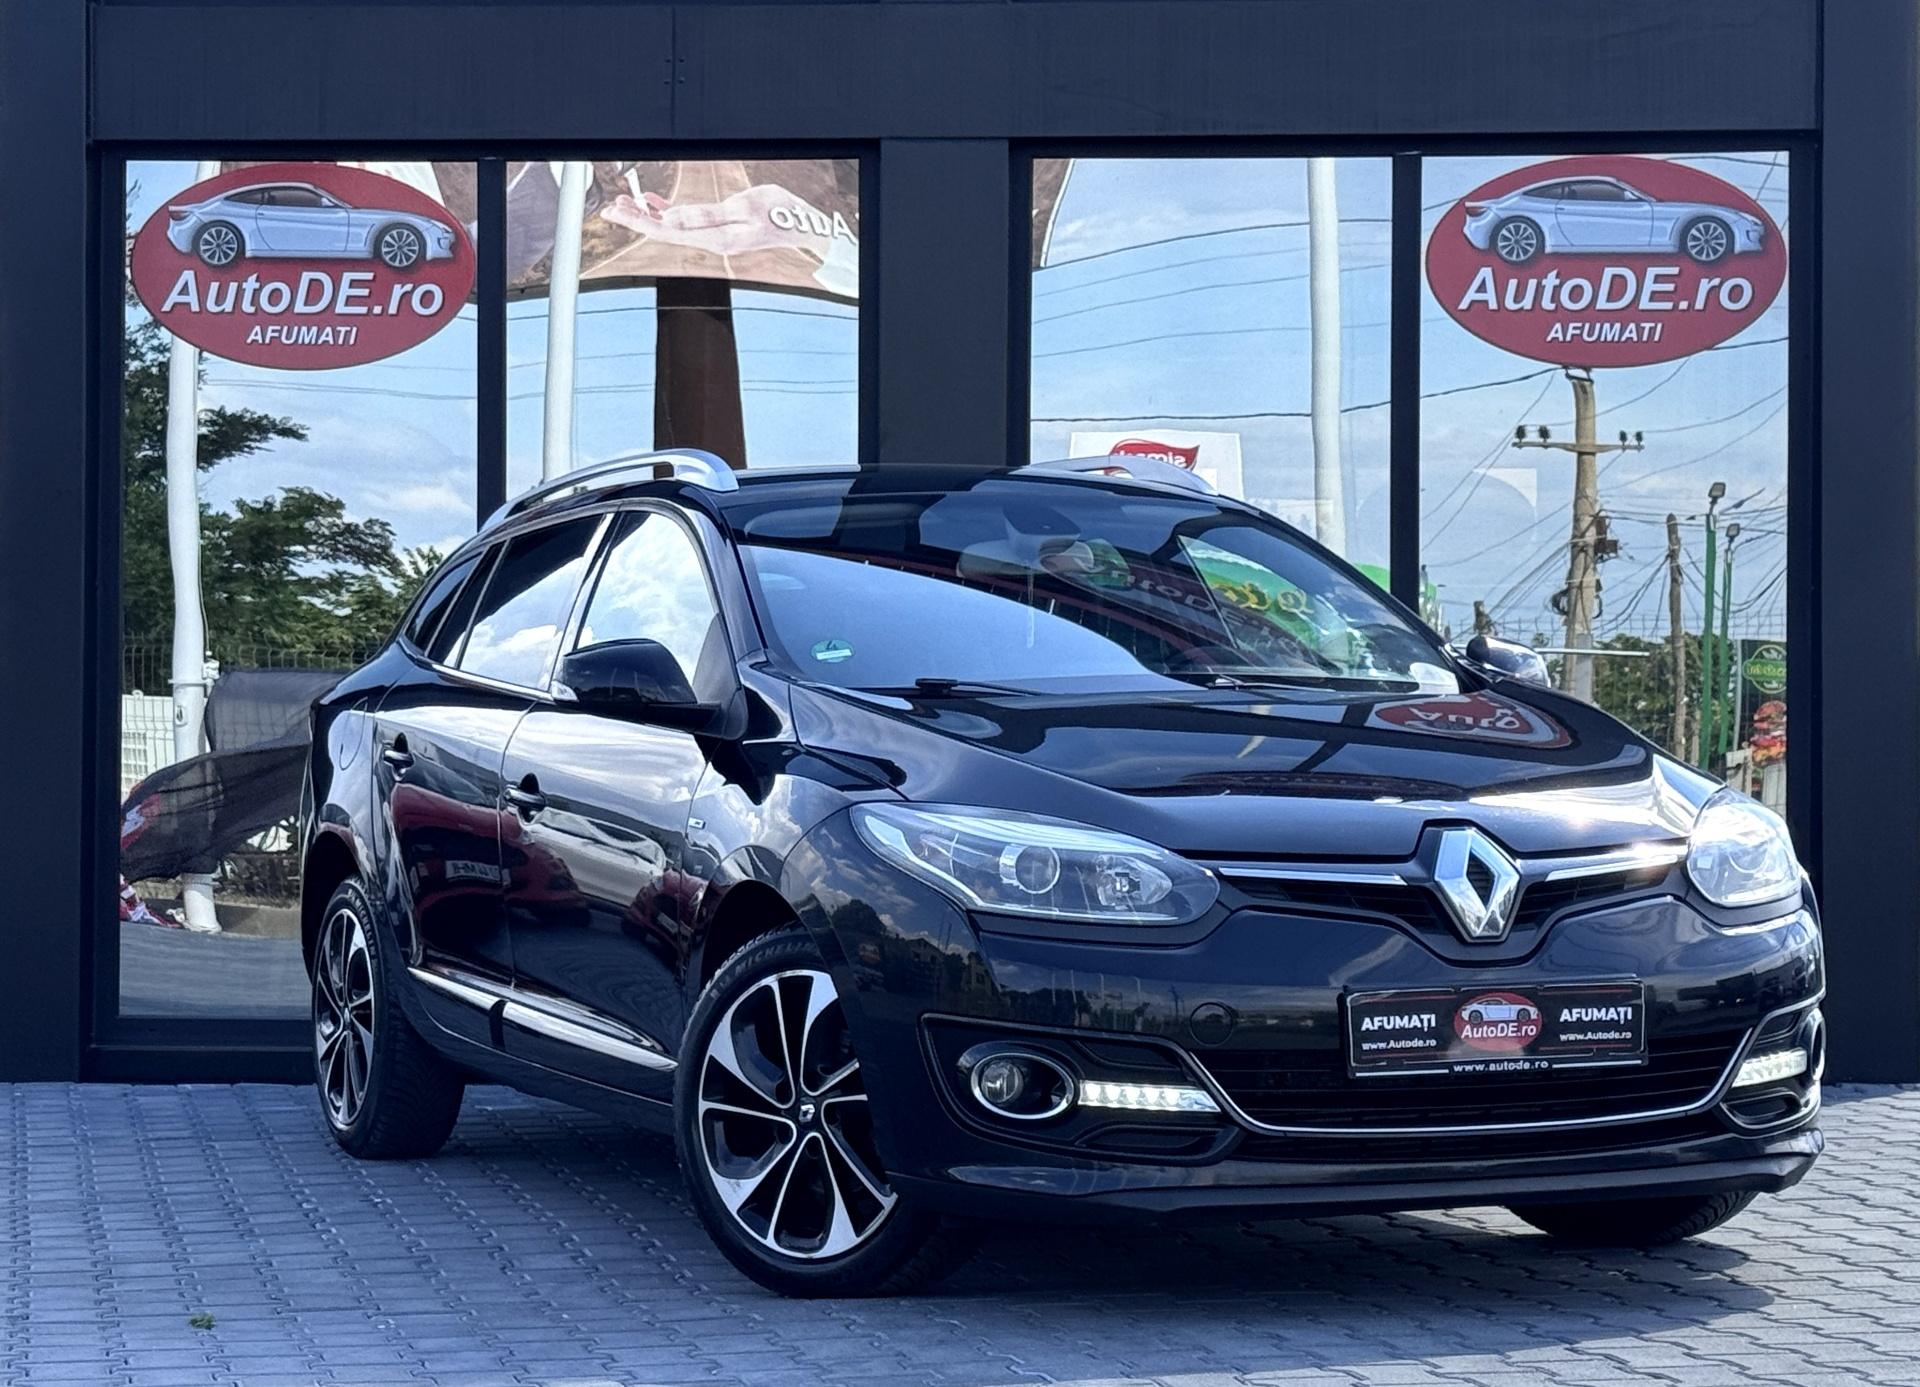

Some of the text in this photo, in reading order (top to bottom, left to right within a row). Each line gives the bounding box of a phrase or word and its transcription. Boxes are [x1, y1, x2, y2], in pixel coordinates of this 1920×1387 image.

[160, 270, 444, 316] AutoDE.ro
[1457, 267, 1754, 312] AutoDE.ro
[246, 326, 358, 346] AFUMATI
[1546, 322, 1663, 342] AFUMATI
[1460, 1022, 1537, 1039] AutoDE.ro
[1559, 1030, 1633, 1042] www.Autode.ro
[1361, 1037, 1437, 1050] www.Autode.ro
[1452, 1060, 1549, 1072] www.autode.ro
